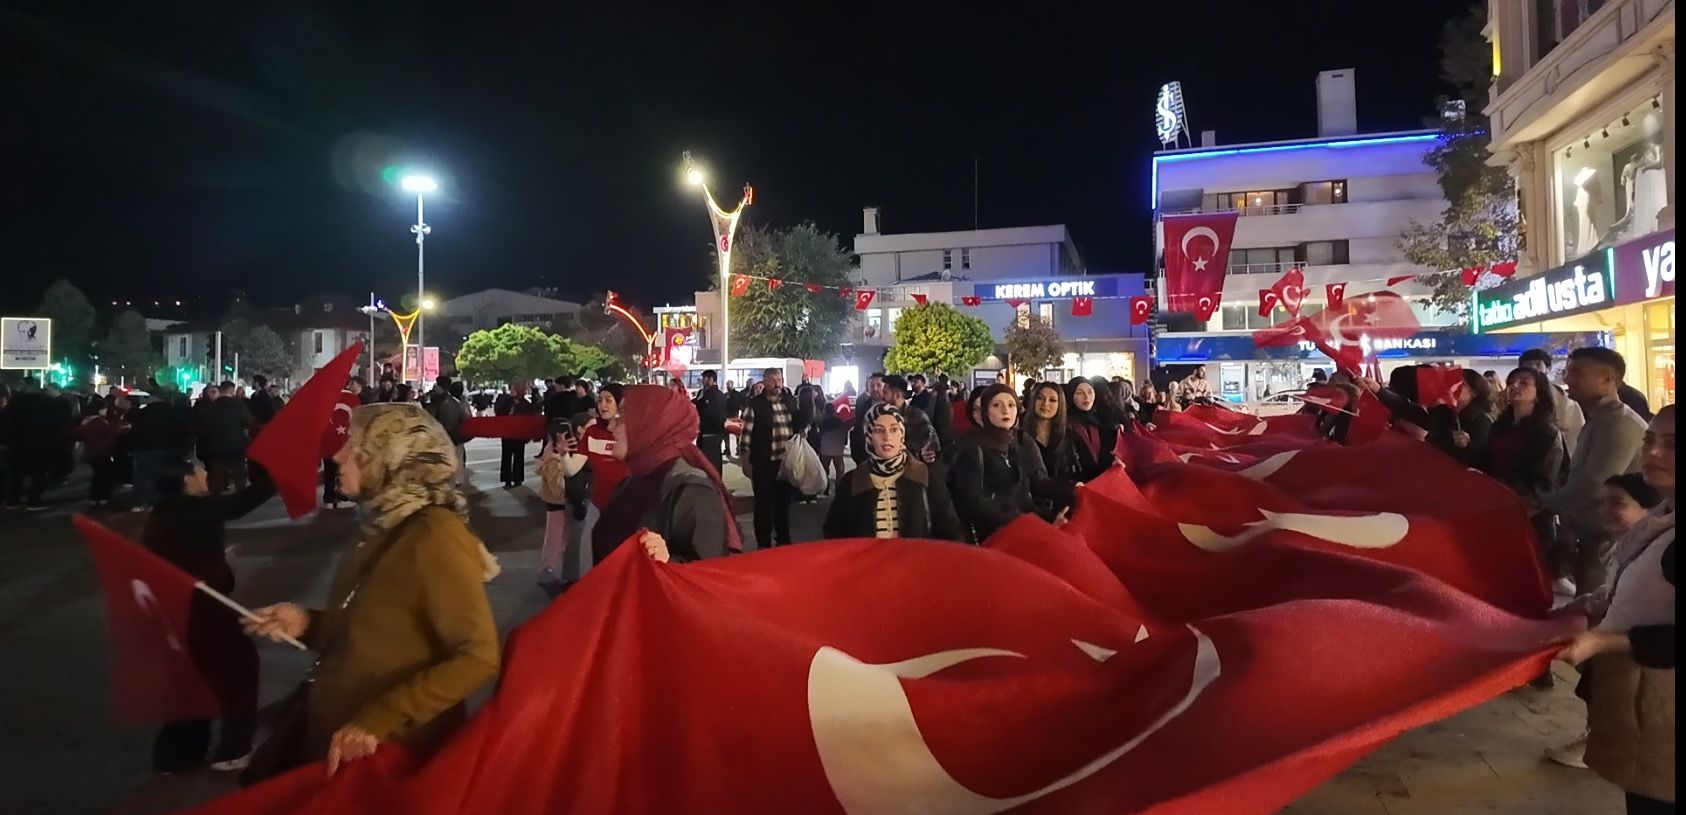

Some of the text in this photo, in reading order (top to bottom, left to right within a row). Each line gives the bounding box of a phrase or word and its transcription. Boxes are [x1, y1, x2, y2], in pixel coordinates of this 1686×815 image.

[995, 283, 1045, 299] KEREM
[1547, 265, 1605, 312] usta
[1373, 337, 1437, 350] BANKASI
